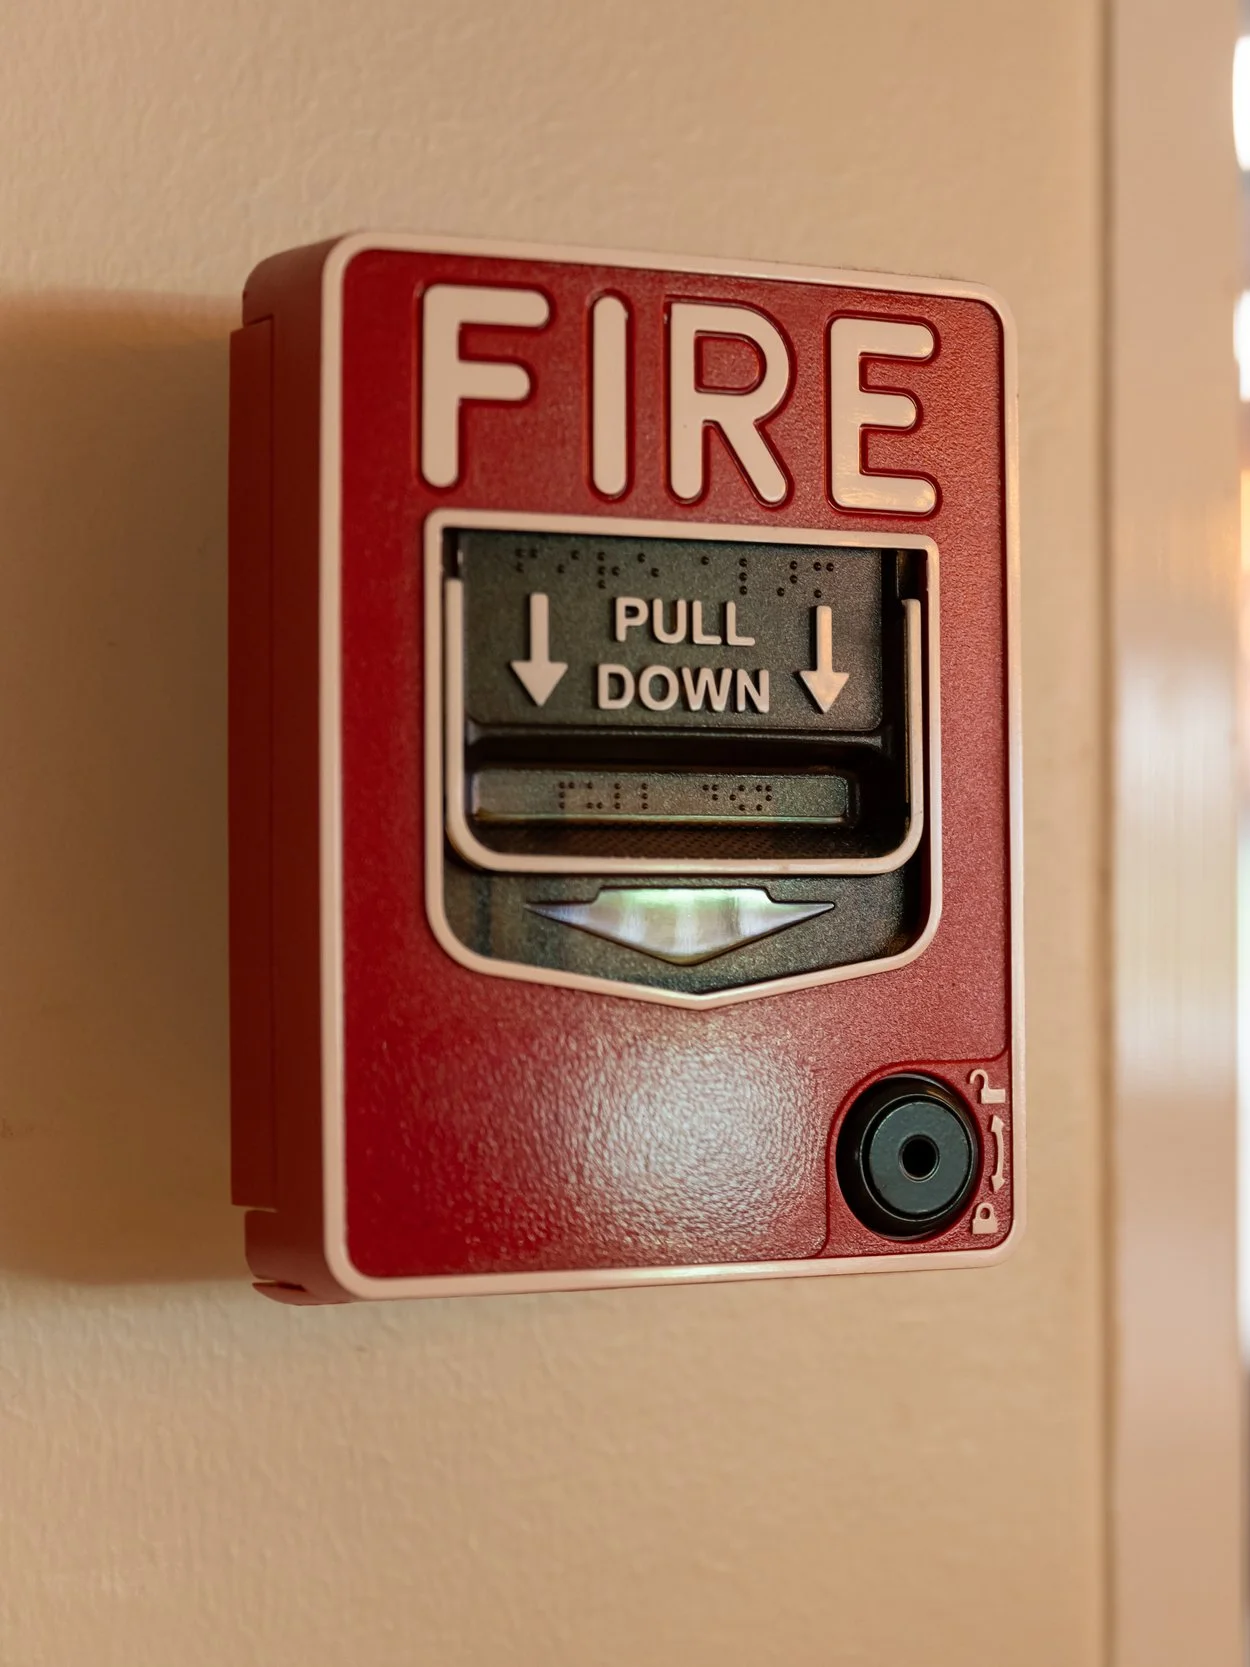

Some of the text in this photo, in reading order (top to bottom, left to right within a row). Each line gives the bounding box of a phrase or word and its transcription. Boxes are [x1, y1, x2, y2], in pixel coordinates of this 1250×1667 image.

[421, 284, 938, 513] FIRE
[615, 597, 756, 647] PULL
[597, 663, 770, 714] DOWN
